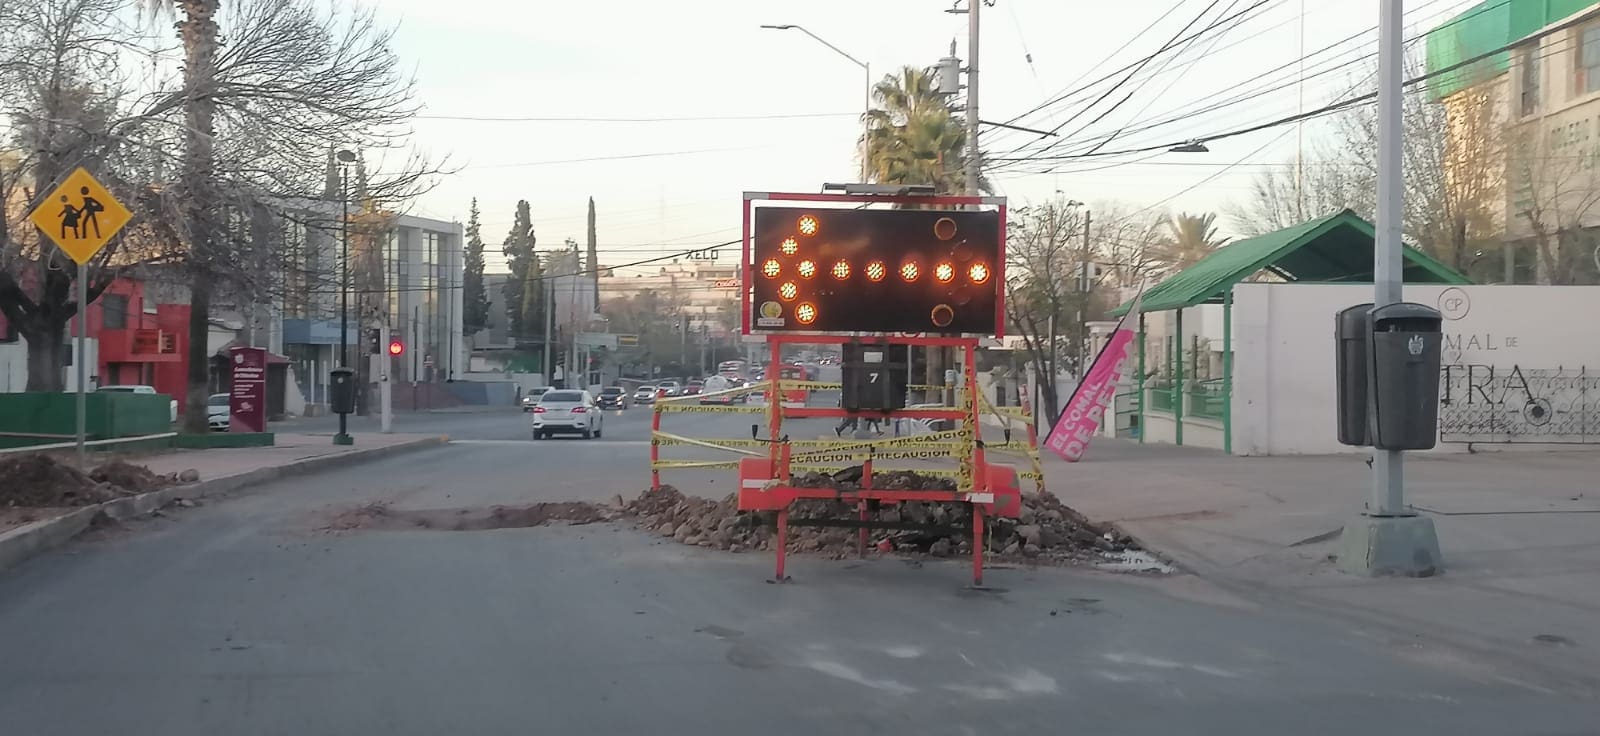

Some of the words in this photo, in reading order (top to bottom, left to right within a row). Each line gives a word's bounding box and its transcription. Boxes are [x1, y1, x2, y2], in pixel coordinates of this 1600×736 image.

[1444, 334, 1498, 350] MAL
[1505, 337, 1518, 347] DE
[869, 373, 879, 384] 7
[1440, 364, 1537, 405] TRA
[1051, 431, 1069, 450] EL
[1063, 381, 1102, 432] COMAL
[1063, 424, 1092, 460] DE
[789, 454, 853, 464] ECAUCION
[869, 450, 950, 460] PRECAUCION
